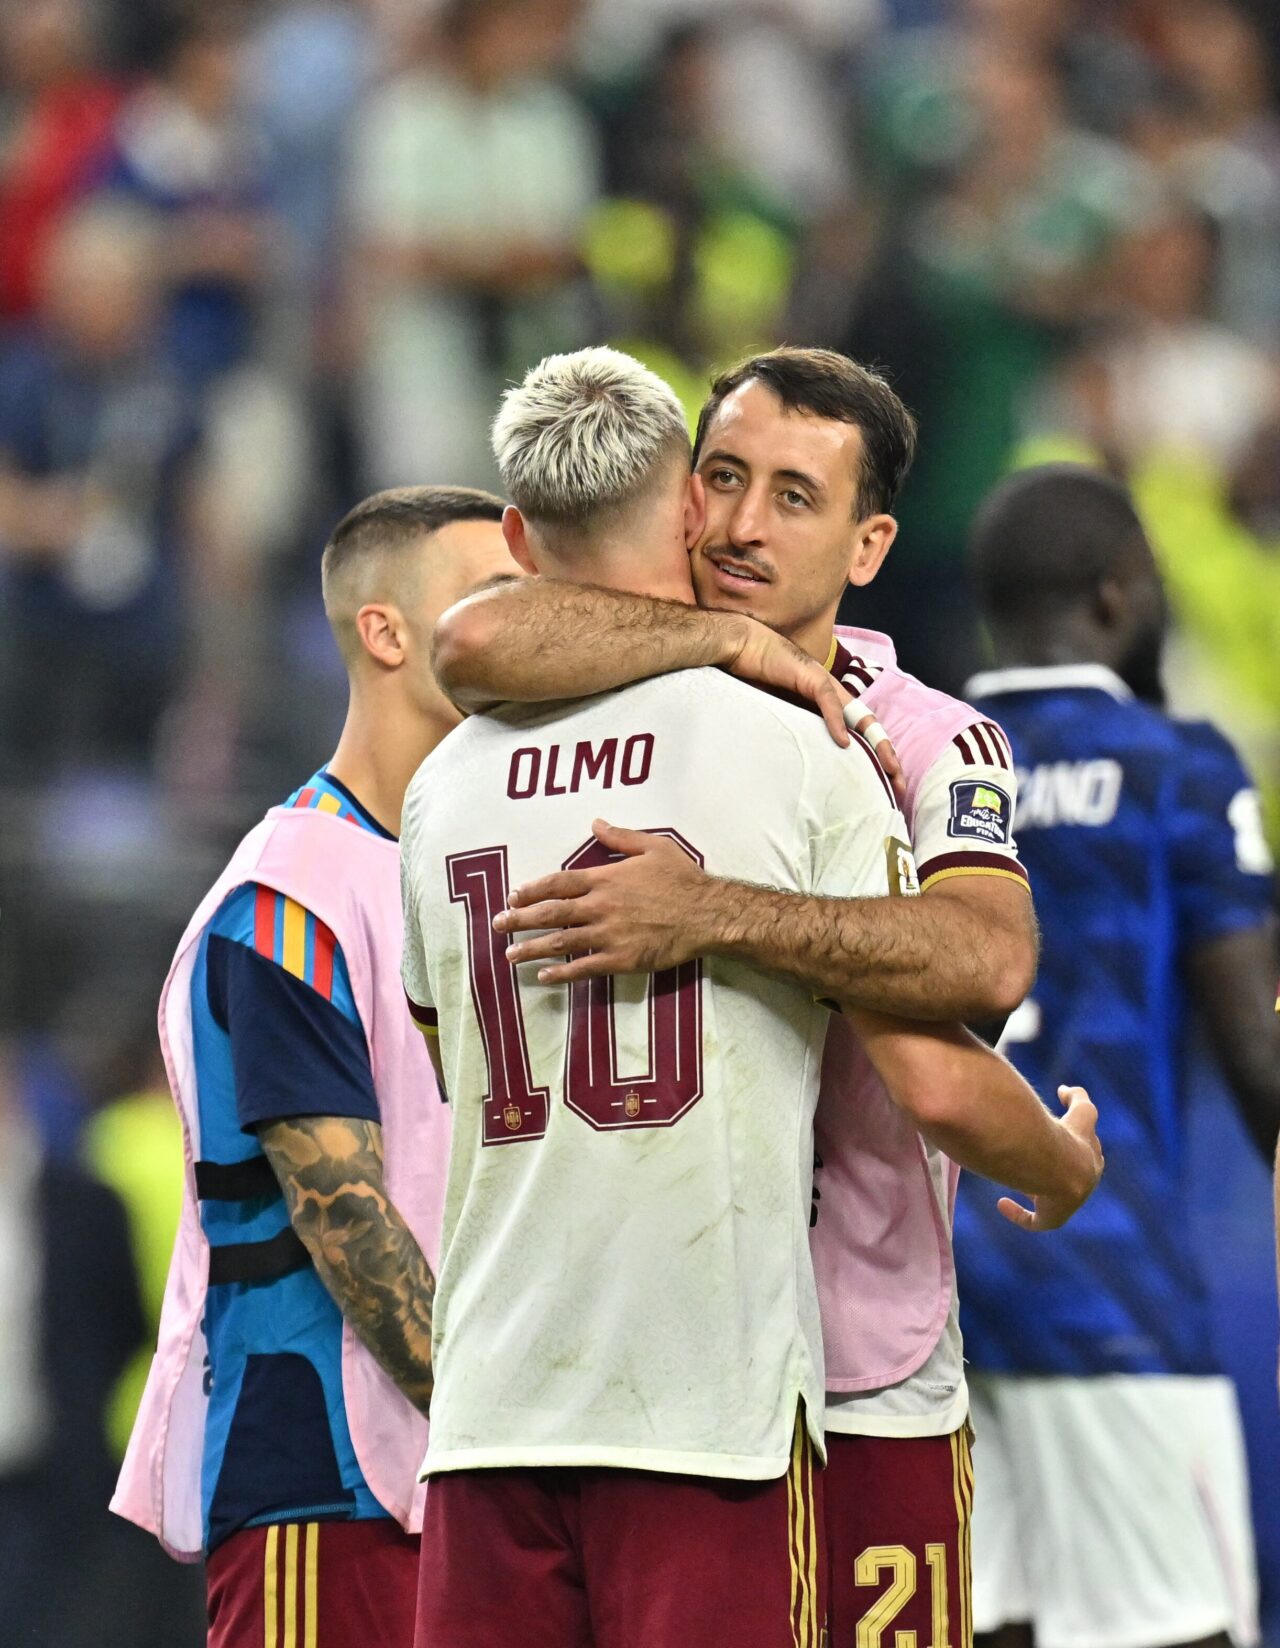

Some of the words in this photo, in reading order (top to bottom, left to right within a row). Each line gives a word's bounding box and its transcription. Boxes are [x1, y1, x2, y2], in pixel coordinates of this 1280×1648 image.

[507, 732, 655, 800] OLMO
[1013, 759, 1124, 832] ANO
[446, 827, 705, 1147] 10
[854, 1543, 953, 1648] 21
